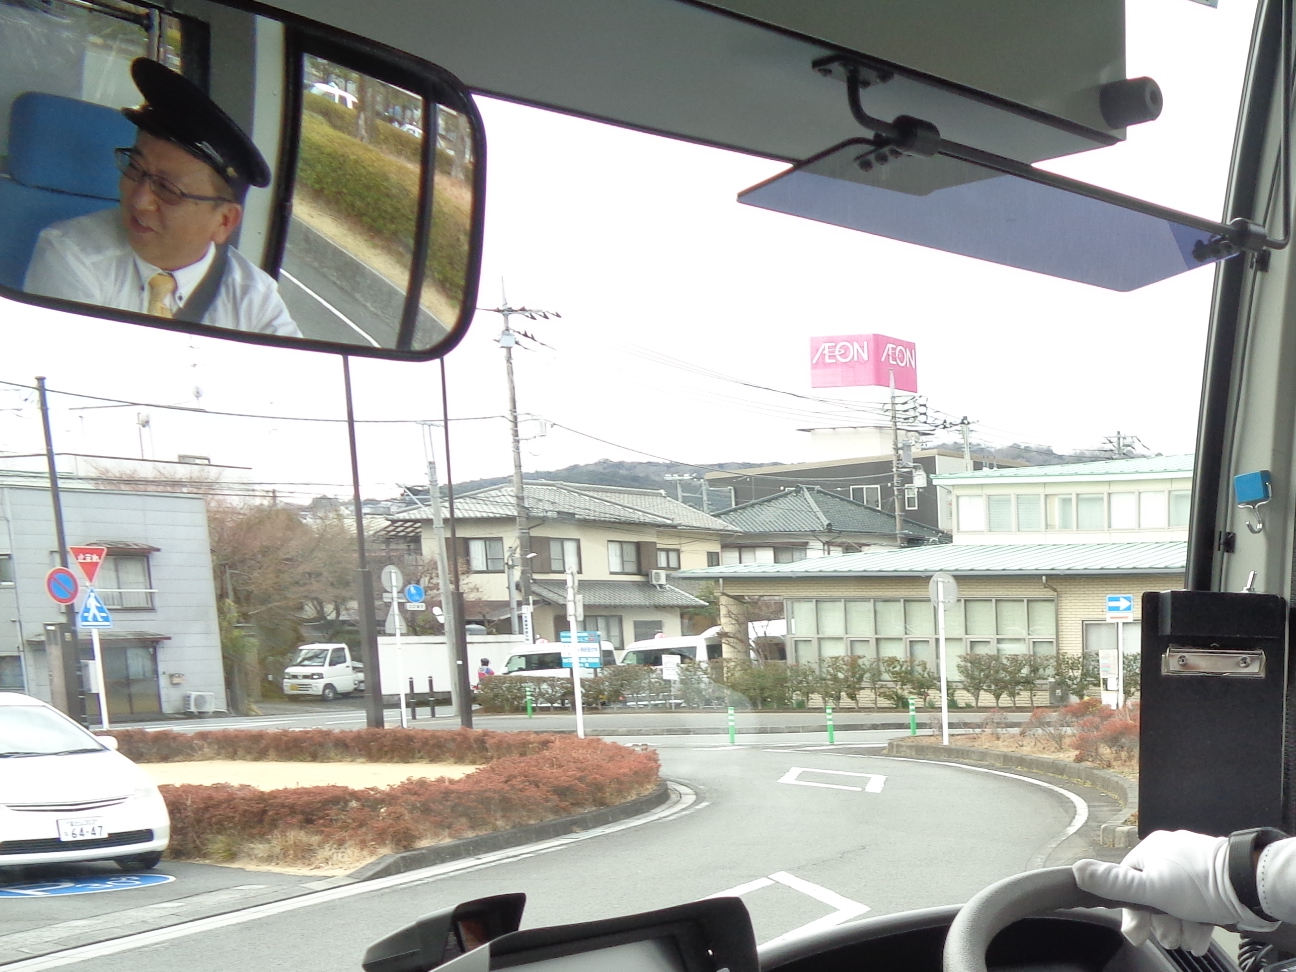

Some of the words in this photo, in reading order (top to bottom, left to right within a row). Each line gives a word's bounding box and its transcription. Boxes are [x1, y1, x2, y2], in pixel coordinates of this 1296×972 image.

[77, 553, 100, 562] 止まれ
[71, 825, 103, 839] 64-47
